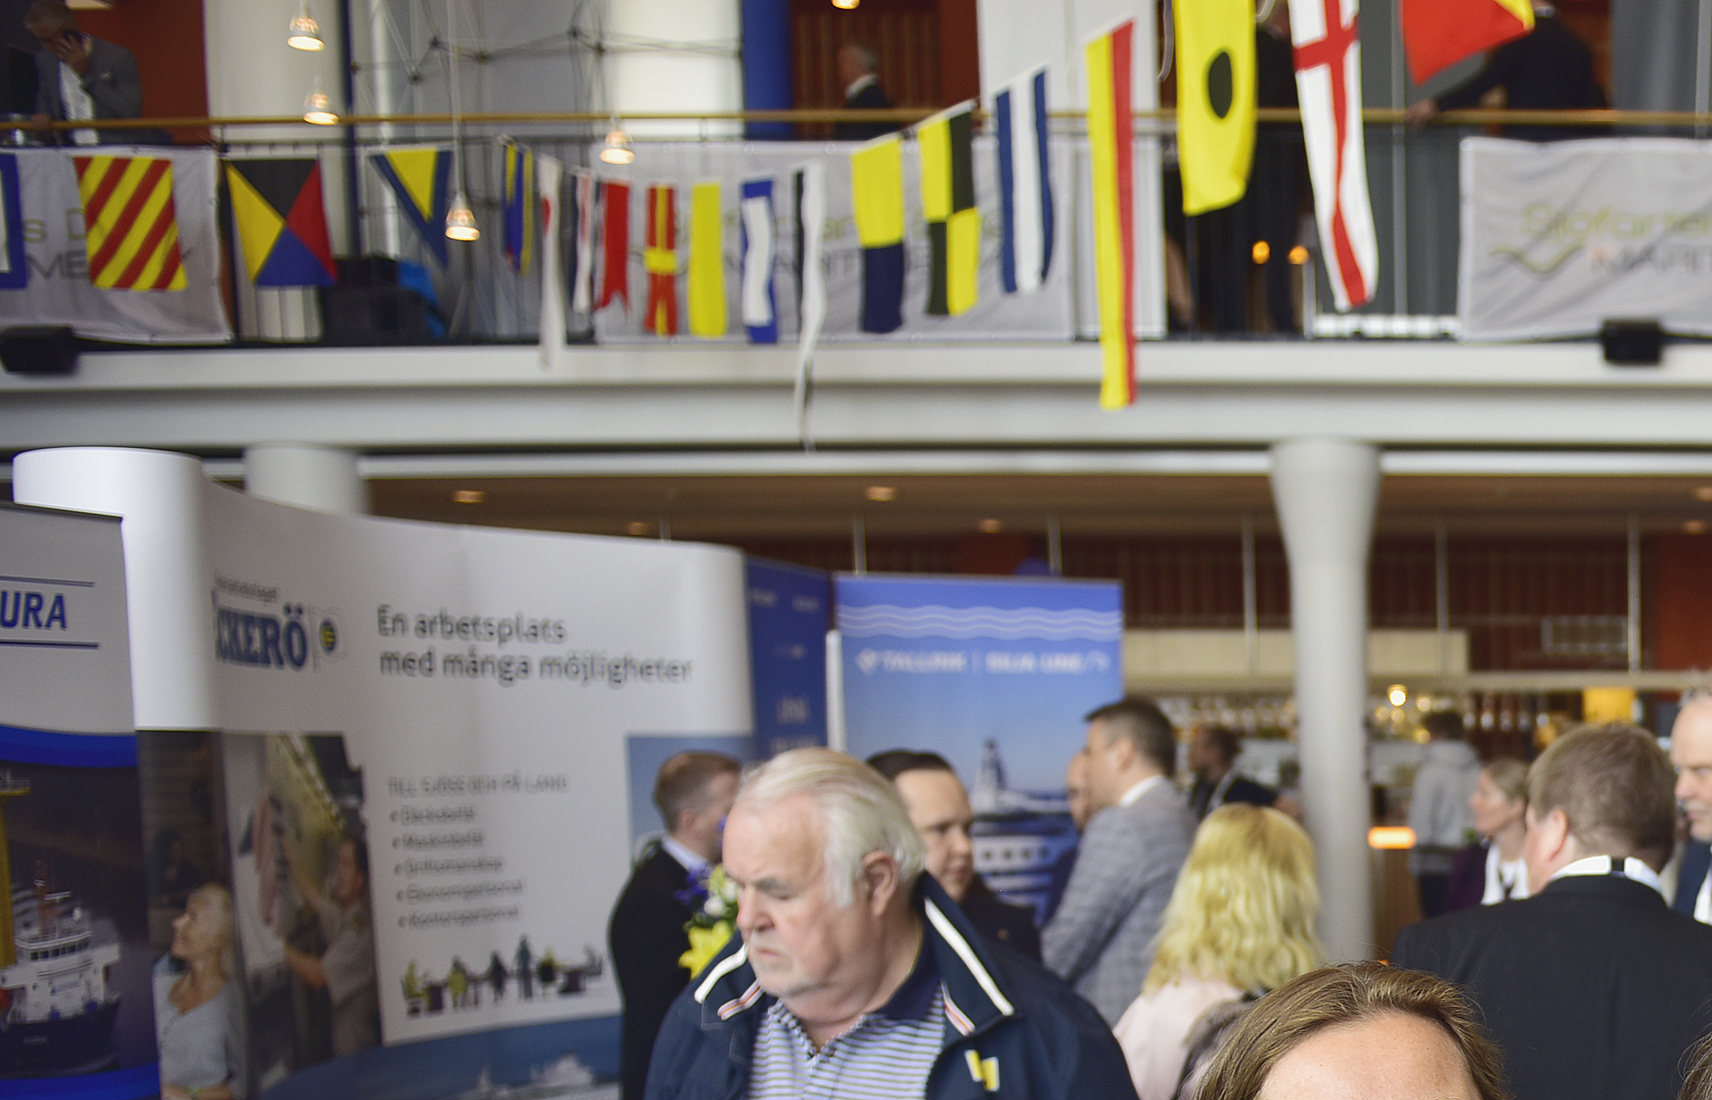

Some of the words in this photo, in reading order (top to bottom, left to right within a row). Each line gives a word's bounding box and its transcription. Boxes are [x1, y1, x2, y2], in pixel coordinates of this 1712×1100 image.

[377, 603, 408, 637] En
[414, 607, 568, 649] arbetsplats
[380, 645, 436, 679] med
[442, 645, 532, 688] många
[540, 650, 692, 689] möjligheter
